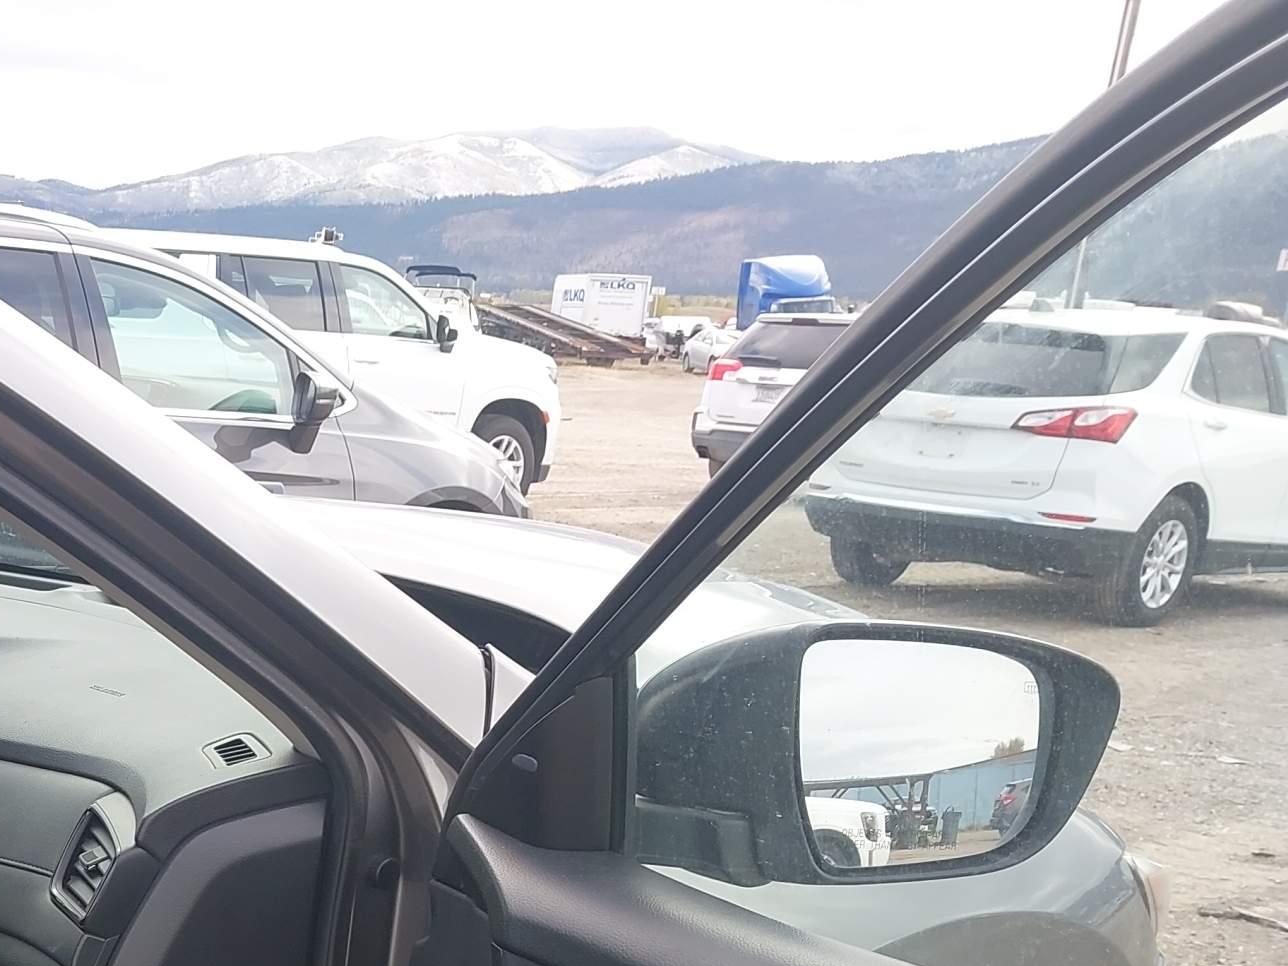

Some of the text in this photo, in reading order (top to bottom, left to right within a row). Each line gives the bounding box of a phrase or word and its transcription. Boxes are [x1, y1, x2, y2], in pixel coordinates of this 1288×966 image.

[610, 278, 636, 290] LKQ
[569, 288, 585, 302] LKQ
[842, 828, 881, 838] OBJES
